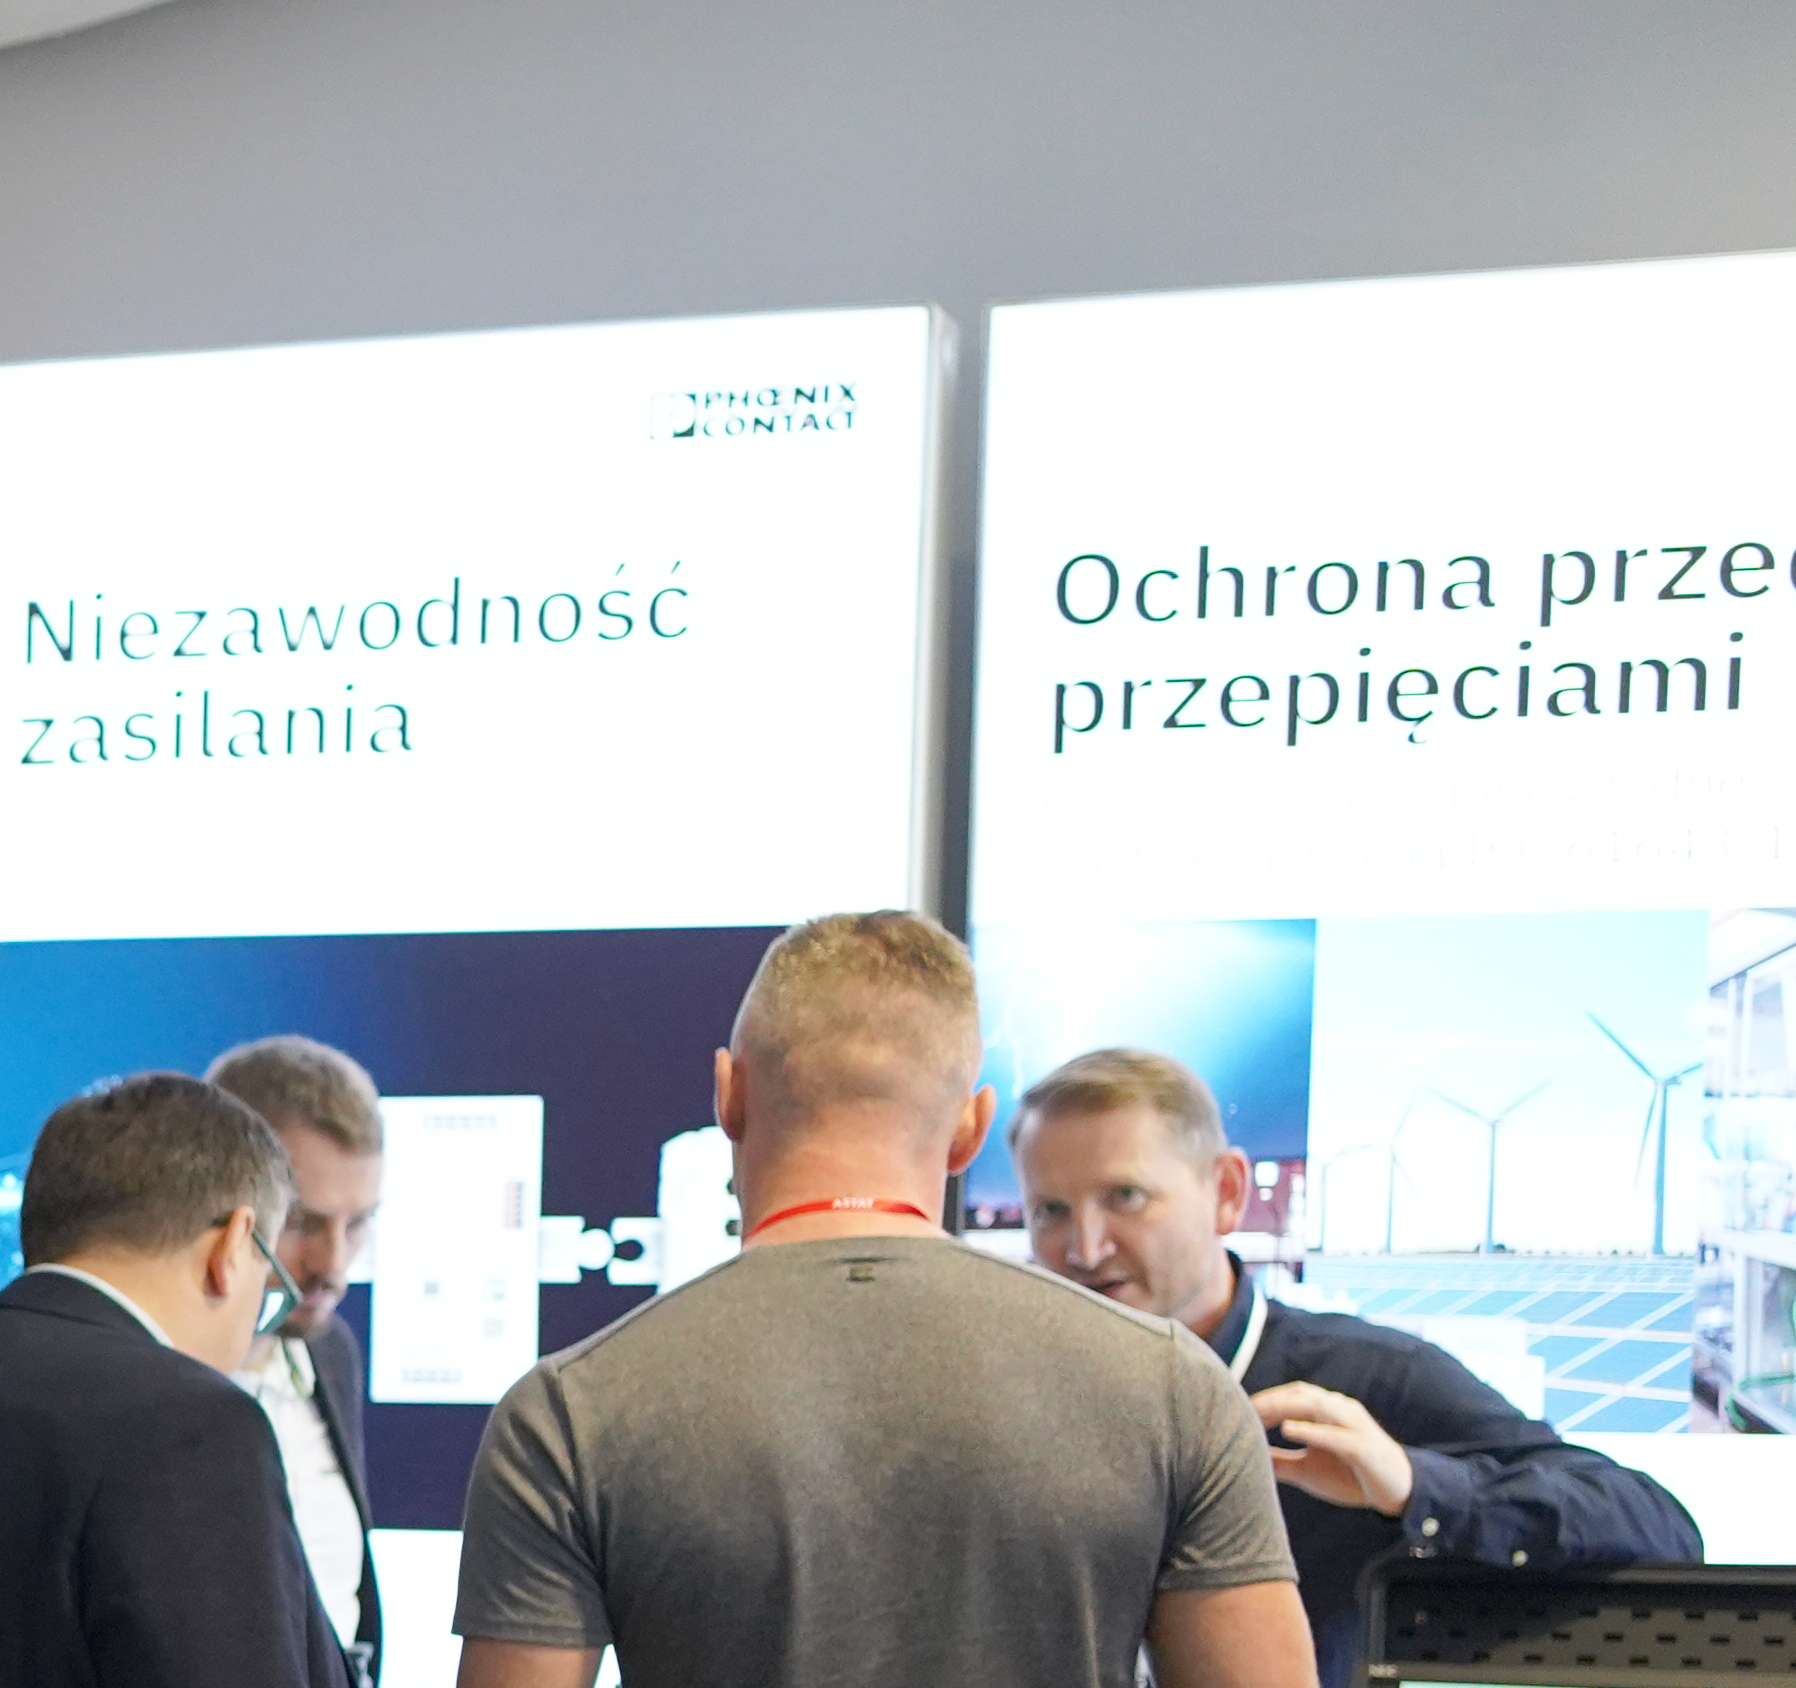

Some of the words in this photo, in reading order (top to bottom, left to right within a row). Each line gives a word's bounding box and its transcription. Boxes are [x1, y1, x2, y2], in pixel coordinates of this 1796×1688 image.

[26, 560, 689, 664] Niezawodność
[1055, 545, 1495, 625] Ochrona
[20, 684, 412, 765] zasilania
[1053, 631, 1744, 754] przepięciami
